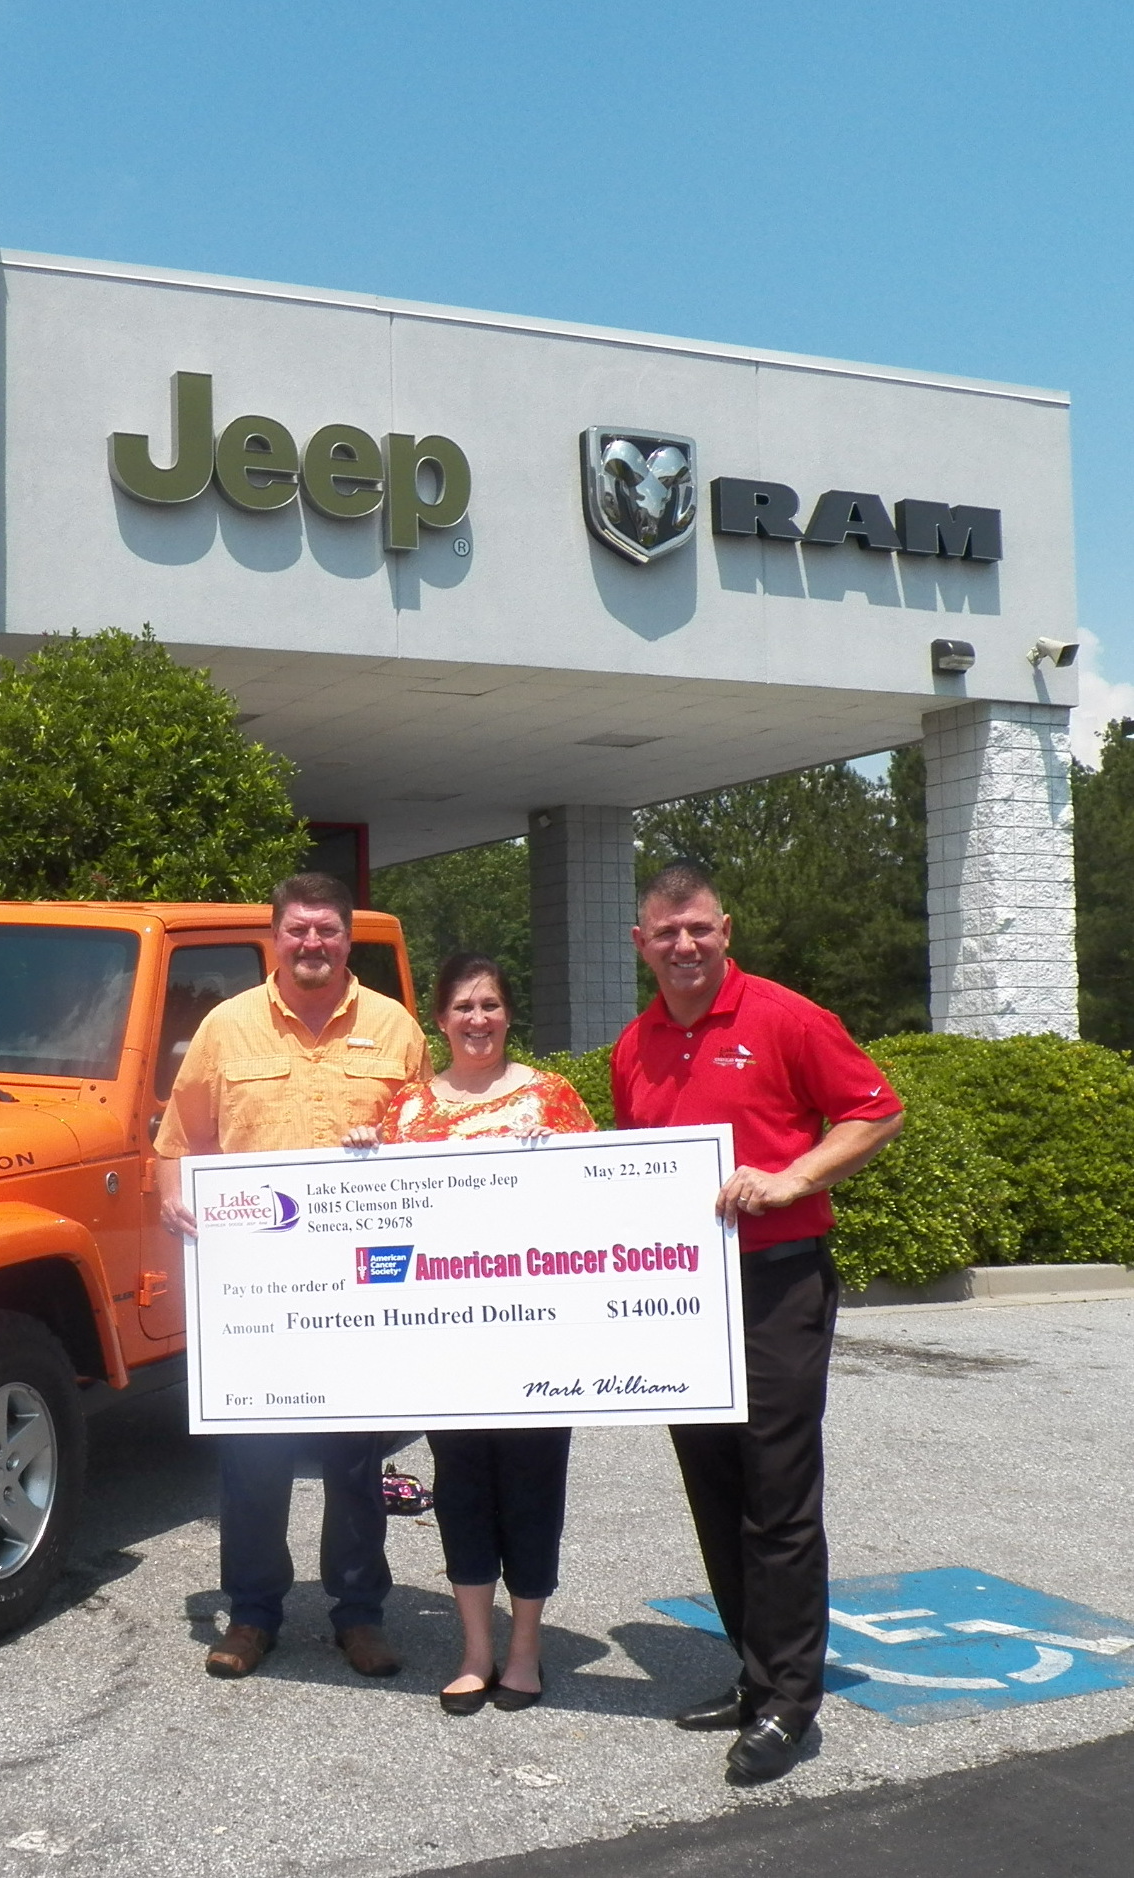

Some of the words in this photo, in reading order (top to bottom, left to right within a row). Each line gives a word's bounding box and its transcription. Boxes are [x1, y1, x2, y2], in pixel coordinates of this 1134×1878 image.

[107, 370, 471, 551] Jeep
[710, 476, 1002, 563] RAM
[583, 1165, 615, 1180] May
[620, 1163, 640, 1178] 22,
[644, 1161, 678, 1175] 2013
[306, 1183, 336, 1196] Lake
[340, 1181, 387, 1194] Keowee
[390, 1177, 444, 1193] Chrysler
[447, 1174, 486, 1190] Dodge
[489, 1173, 518, 1188] Jeep
[219, 1190, 260, 1208] Lake
[308, 1201, 342, 1214] 10815
[345, 1200, 397, 1213] Clemson
[402, 1196, 434, 1210] Blvd.
[204, 1206, 272, 1222] Keowee
[308, 1220, 352, 1234] Seneca,
[356, 1218, 374, 1231] SC
[378, 1216, 413, 1230] 29678
[370, 1254, 407, 1262] American
[370, 1261, 397, 1269] Cancer
[416, 1251, 522, 1281] American
[526, 1248, 608, 1276] Cancer
[612, 1242, 699, 1272] Society
[222, 1283, 247, 1298] Pay
[251, 1284, 263, 1295] to
[267, 1281, 287, 1294] the
[291, 1280, 328, 1293] order
[332, 1279, 346, 1291] of
[222, 1322, 275, 1336] Amount
[286, 1311, 375, 1330] Fourteen
[383, 1306, 474, 1326] Hundred
[482, 1304, 556, 1323] Dollars
[607, 1296, 701, 1319] $1400.00
[522, 1378, 585, 1398] Mark
[592, 1375, 690, 1395] Williams
[225, 1394, 254, 1406] For:
[265, 1392, 326, 1405] Donation
